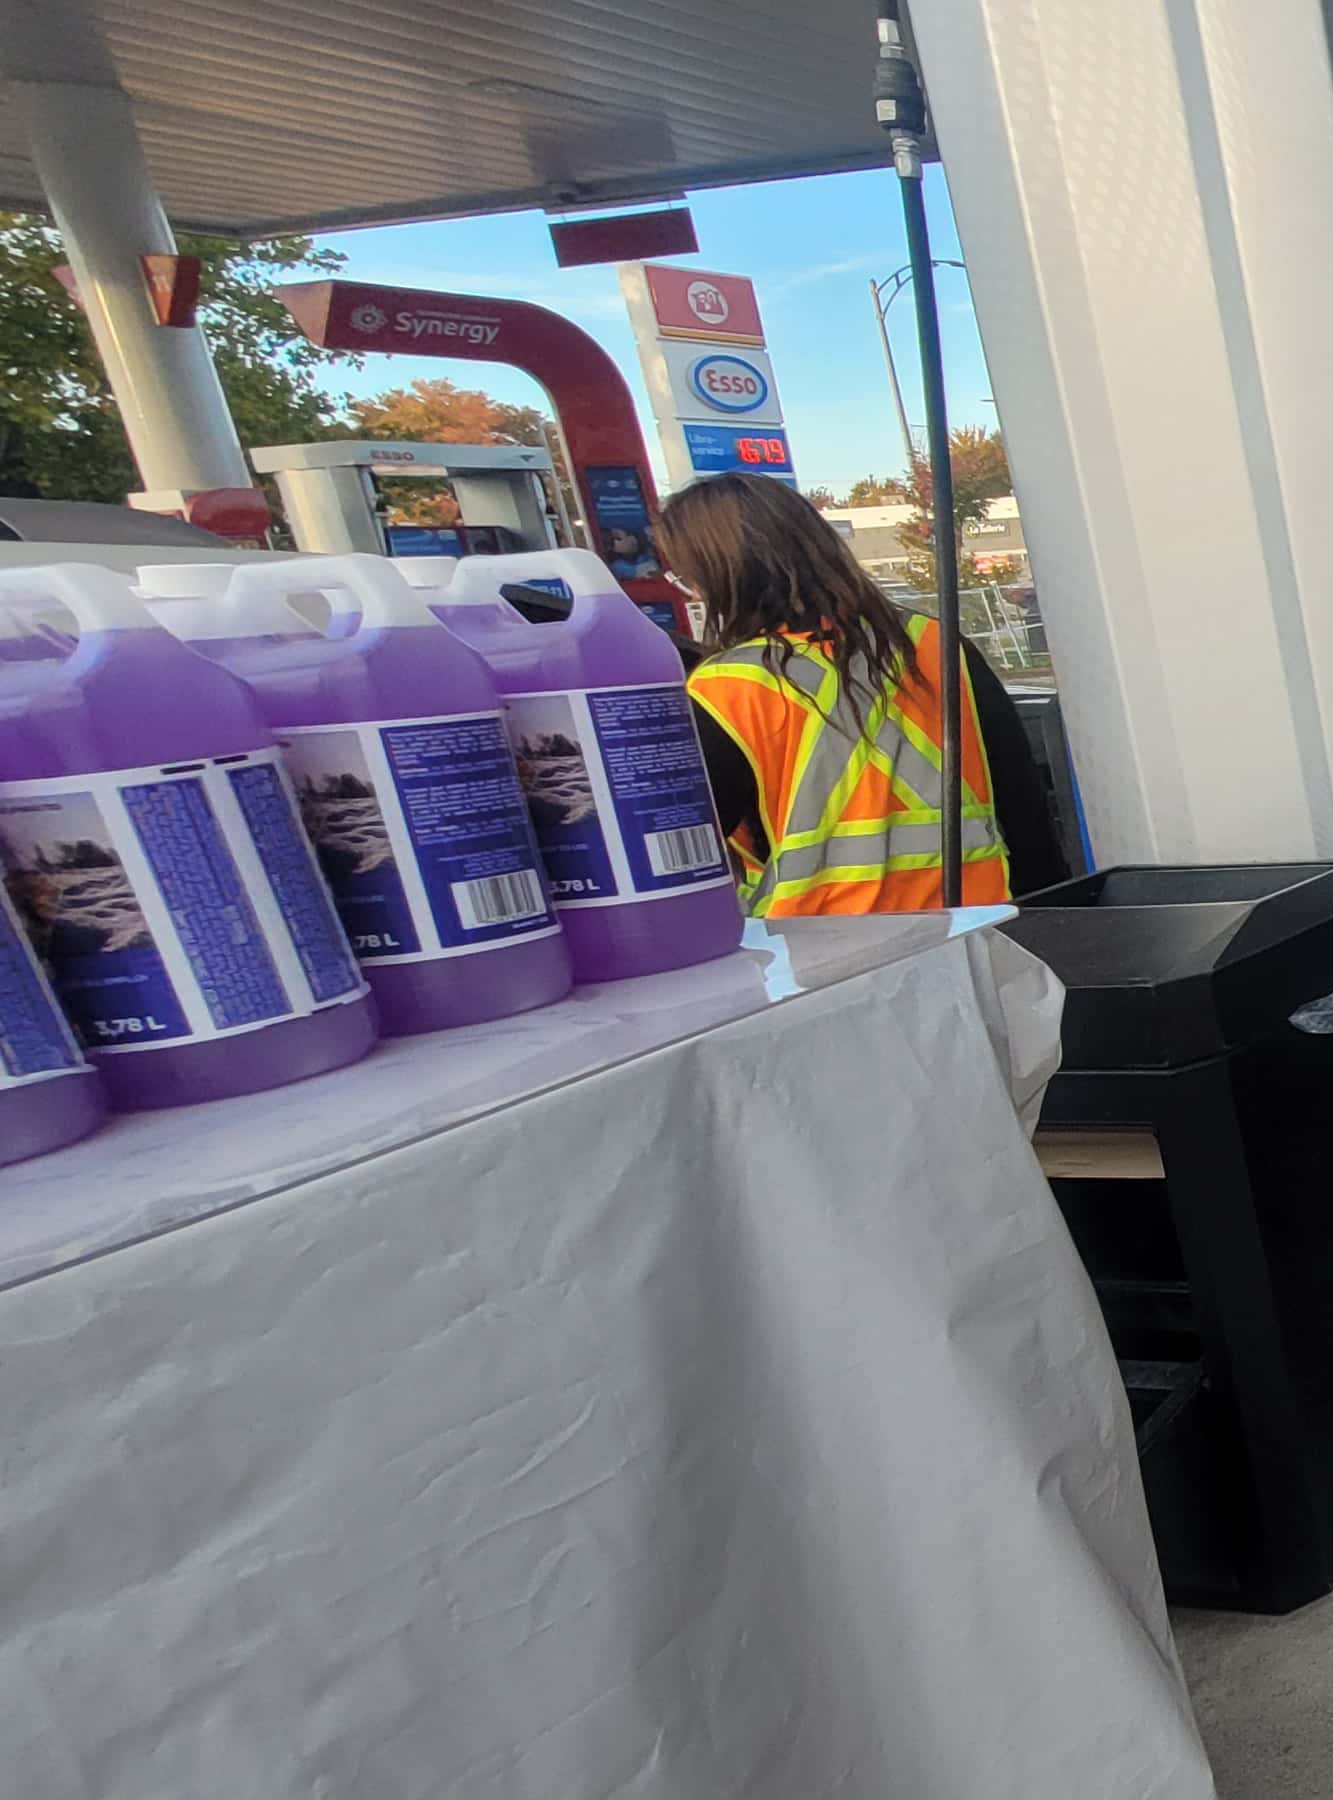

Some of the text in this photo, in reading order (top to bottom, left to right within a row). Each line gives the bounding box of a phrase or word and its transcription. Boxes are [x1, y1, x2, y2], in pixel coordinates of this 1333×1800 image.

[395, 312, 499, 344] Synergy
[586, 879, 601, 891] L
[383, 933, 401, 947] L
[145, 1015, 168, 1031] L
